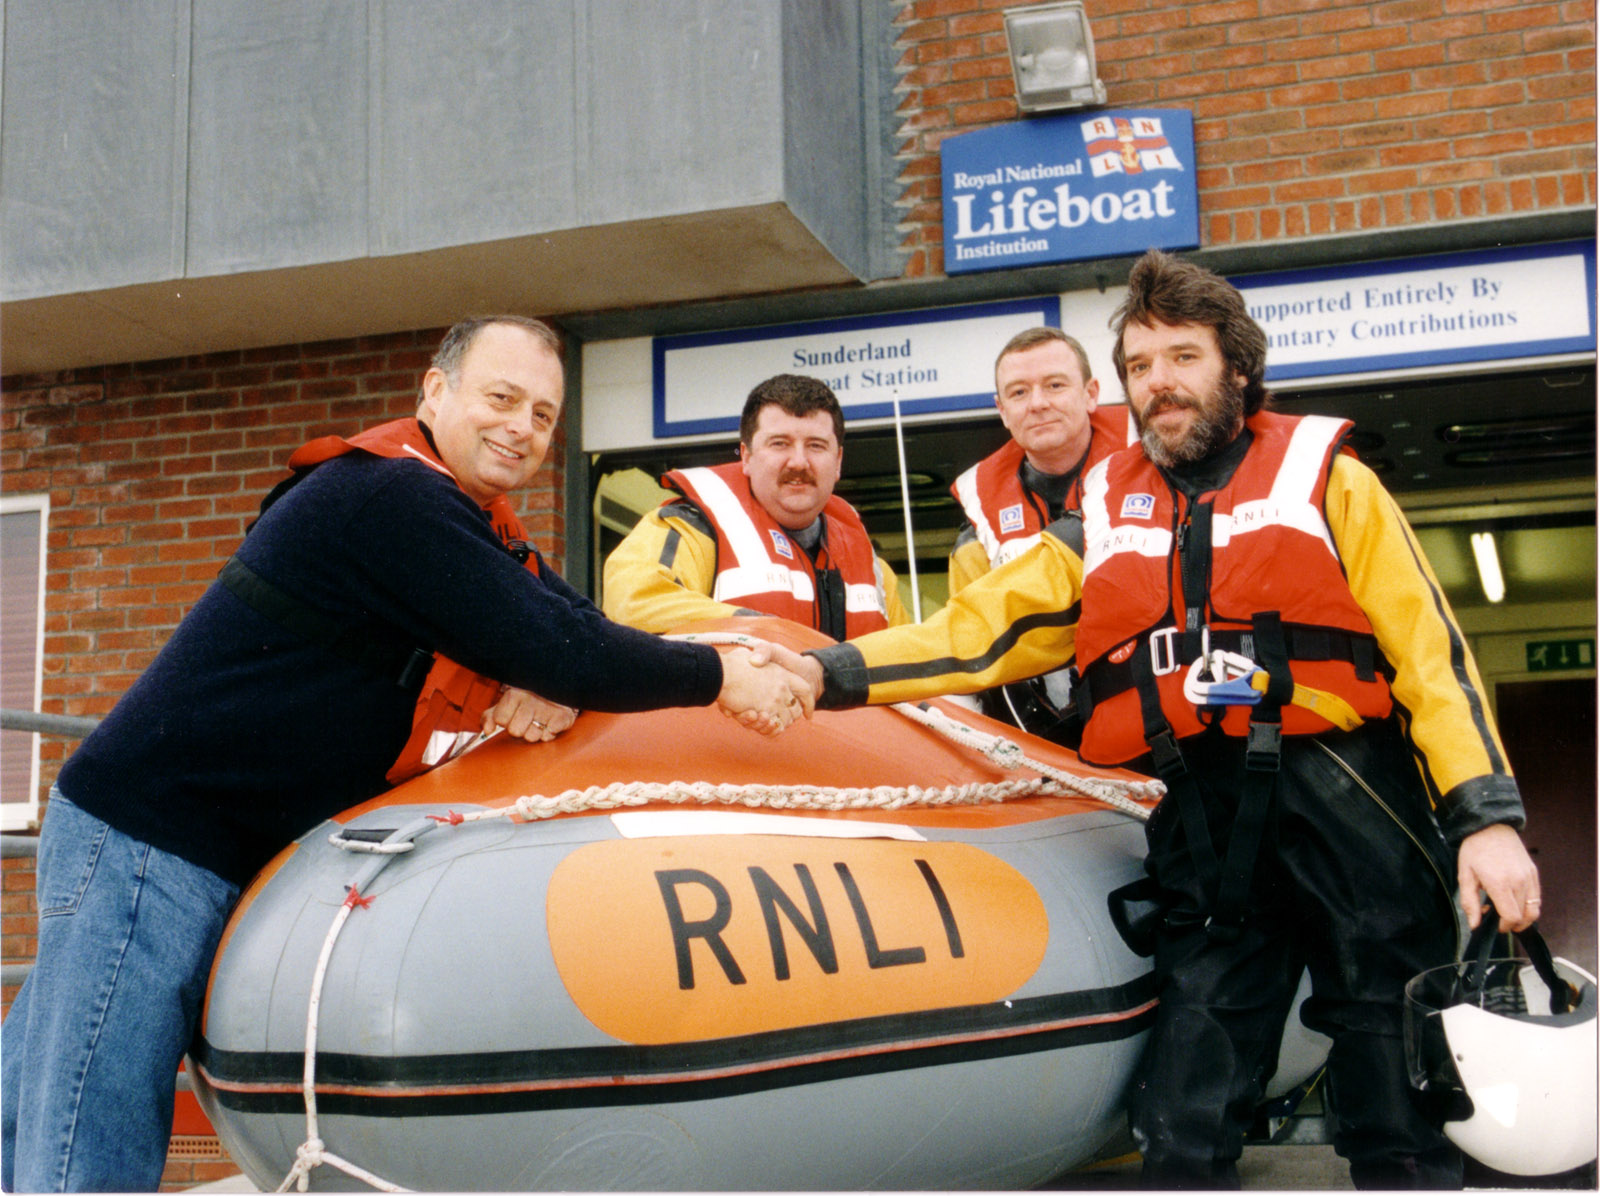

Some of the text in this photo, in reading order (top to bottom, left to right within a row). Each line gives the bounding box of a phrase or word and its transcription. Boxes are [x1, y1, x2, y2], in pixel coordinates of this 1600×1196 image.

[1093, 120, 1155, 135] R N
[954, 158, 1083, 191] Royal National
[1104, 157, 1116, 171] L
[952, 179, 1176, 240] Lifeboat
[955, 237, 1049, 261] Institution
[1250, 276, 1504, 323] upported Entirely By
[1268, 309, 1518, 348] ntary Contributions
[792, 338, 912, 368] Sunderland
[860, 366, 938, 390] Station
[654, 858, 966, 991] RNLI
